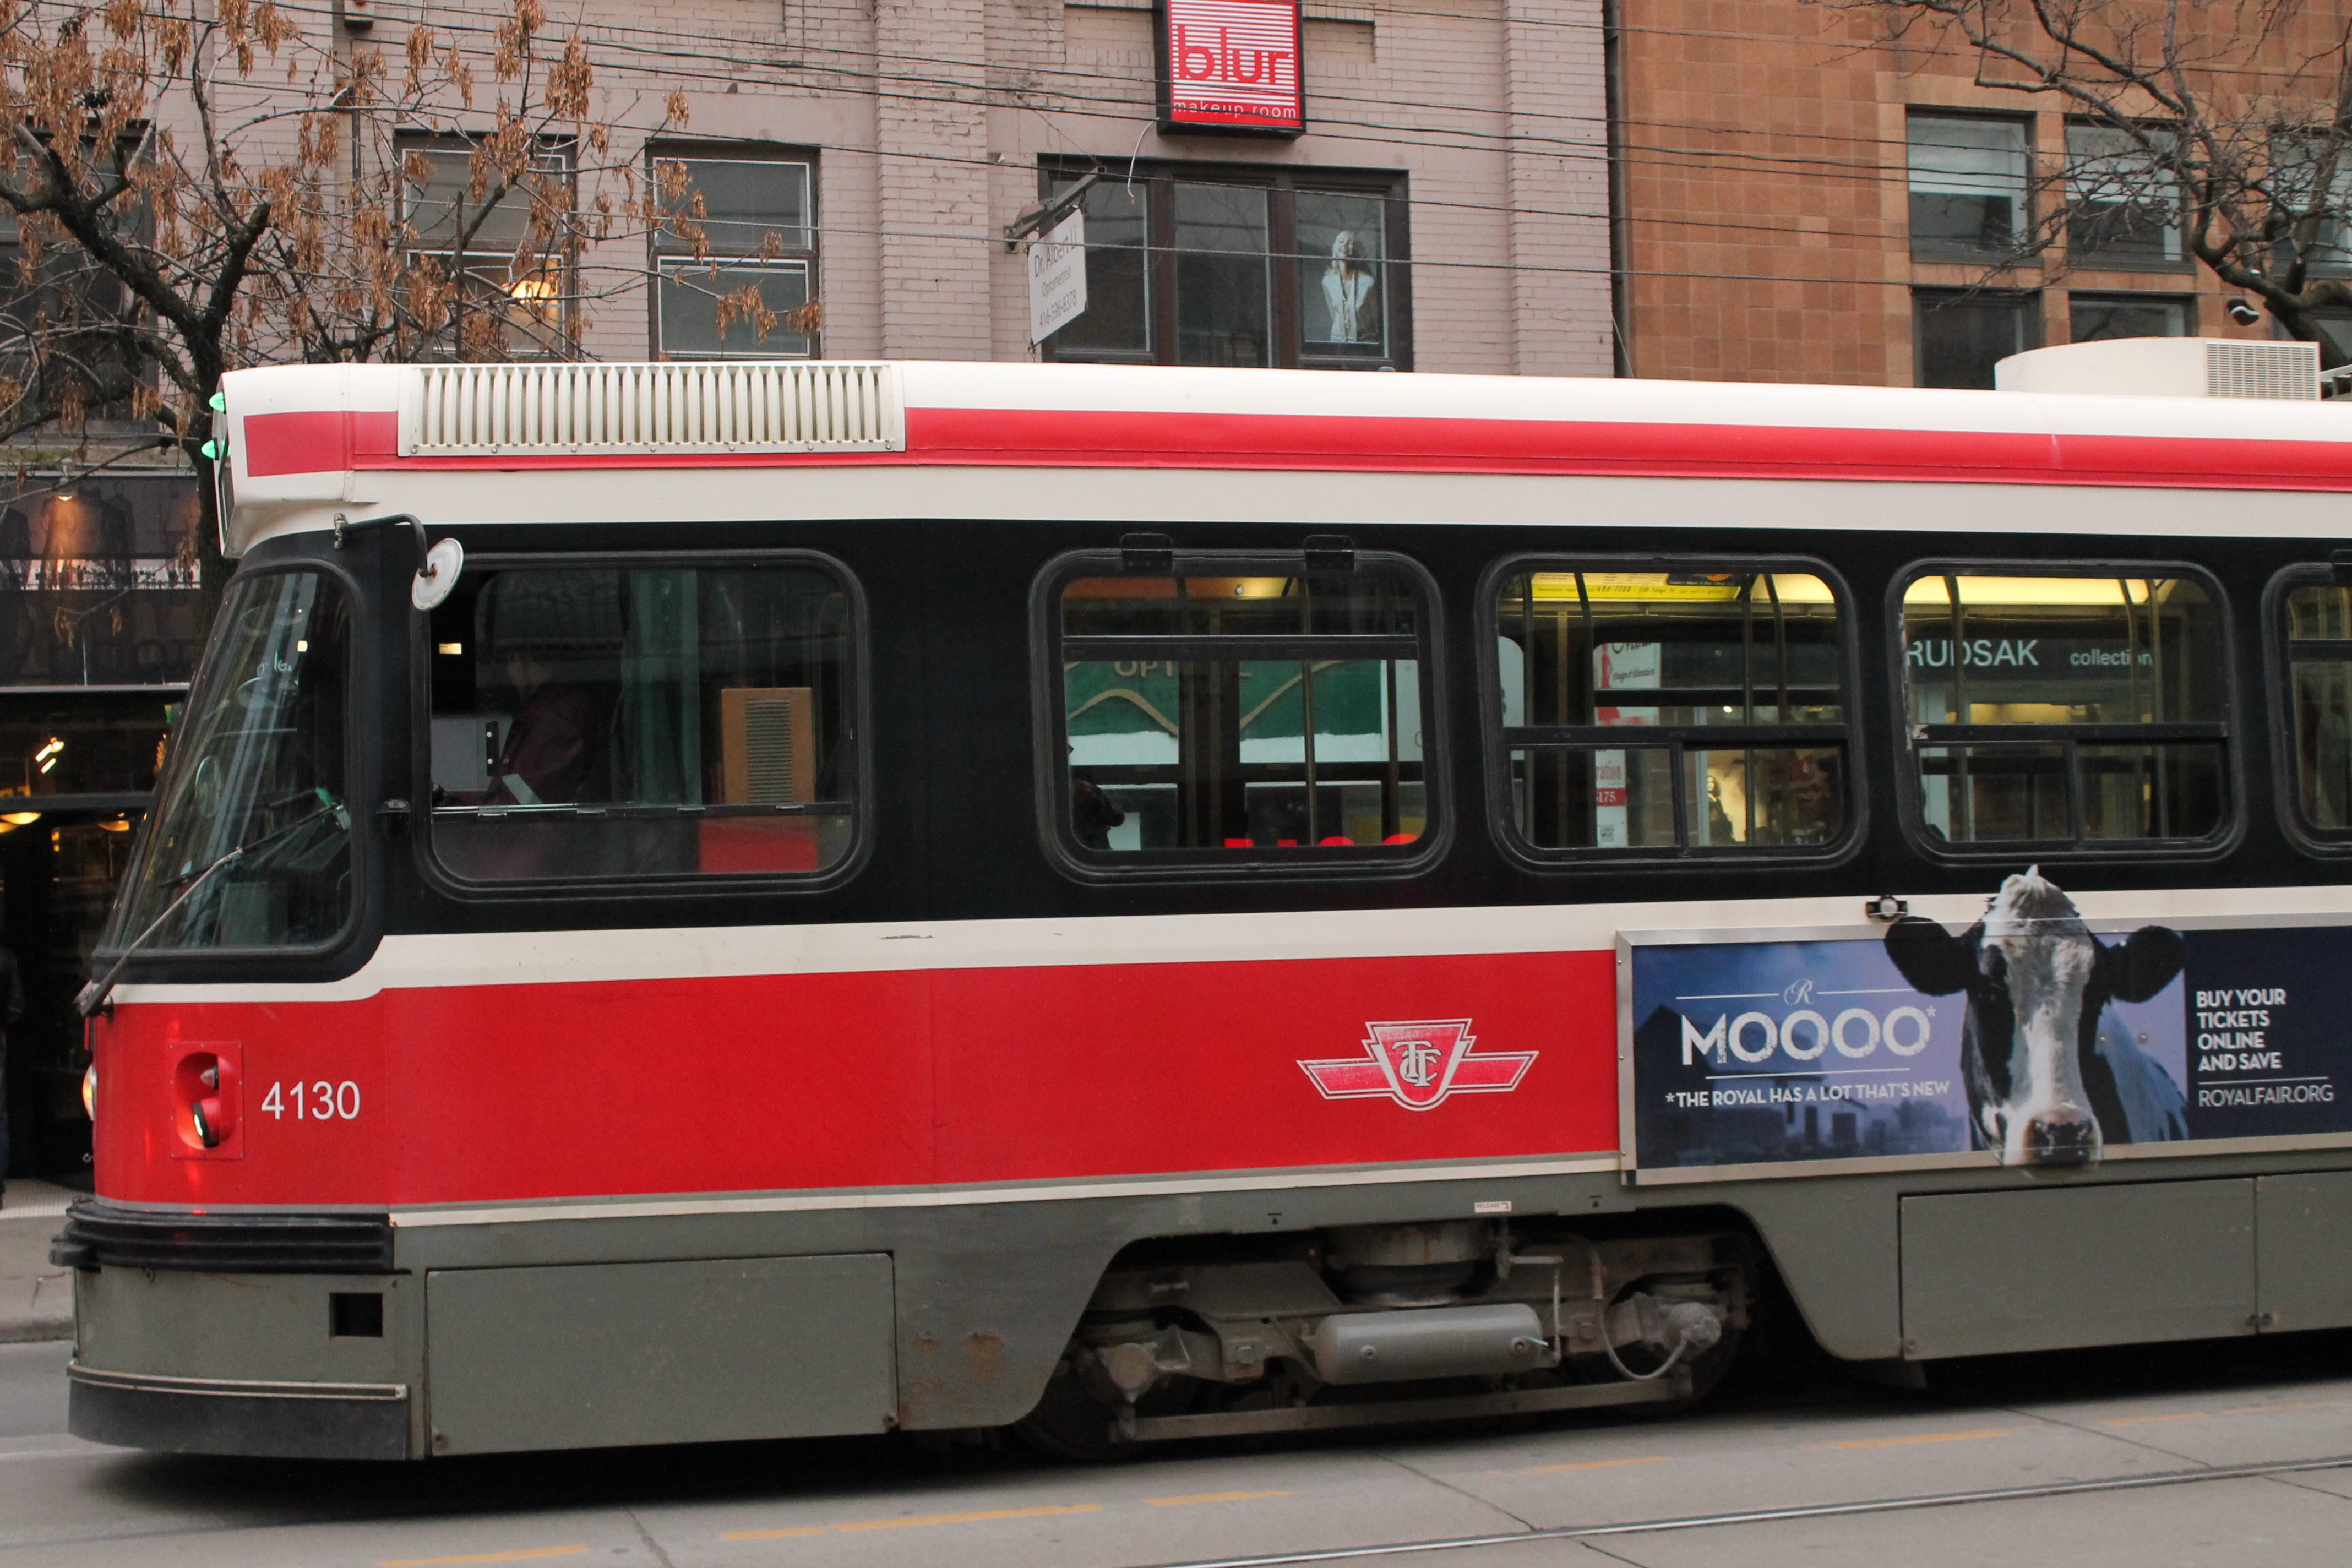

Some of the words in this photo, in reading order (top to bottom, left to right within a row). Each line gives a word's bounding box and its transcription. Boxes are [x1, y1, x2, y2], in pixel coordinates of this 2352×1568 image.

[1178, 25, 1292, 84] blur
[1173, 101, 1243, 118] makeup
[1253, 107, 1296, 118] room
[1034, 254, 1045, 277] Dr.
[1047, 235, 1069, 265] Albert
[1070, 225, 1077, 250] Li
[1042, 264, 1071, 298] Optometrist
[1907, 640, 2039, 667] RUDSAK
[2070, 649, 2153, 666] collectin
[2196, 990, 2233, 1008] BUY
[2235, 988, 2286, 1006] YOUR
[2196, 1010, 2271, 1028] TICKETS
[2197, 1031, 2266, 1050] ONLINE
[2198, 1054, 2237, 1071] AND
[2239, 1052, 2283, 1070] SAVE
[261, 1081, 360, 1120] 4130
[1712, 1090, 1766, 1105] ROYAL
[1770, 1087, 1803, 1103] HAS
[1805, 1086, 1816, 1101] A
[1820, 1084, 1851, 1100] LOT
[1855, 1082, 1910, 1098] THAT'S
[1913, 1081, 1950, 1096] NEW
[2198, 1084, 2335, 1107] ROYALFAIR.ORG
